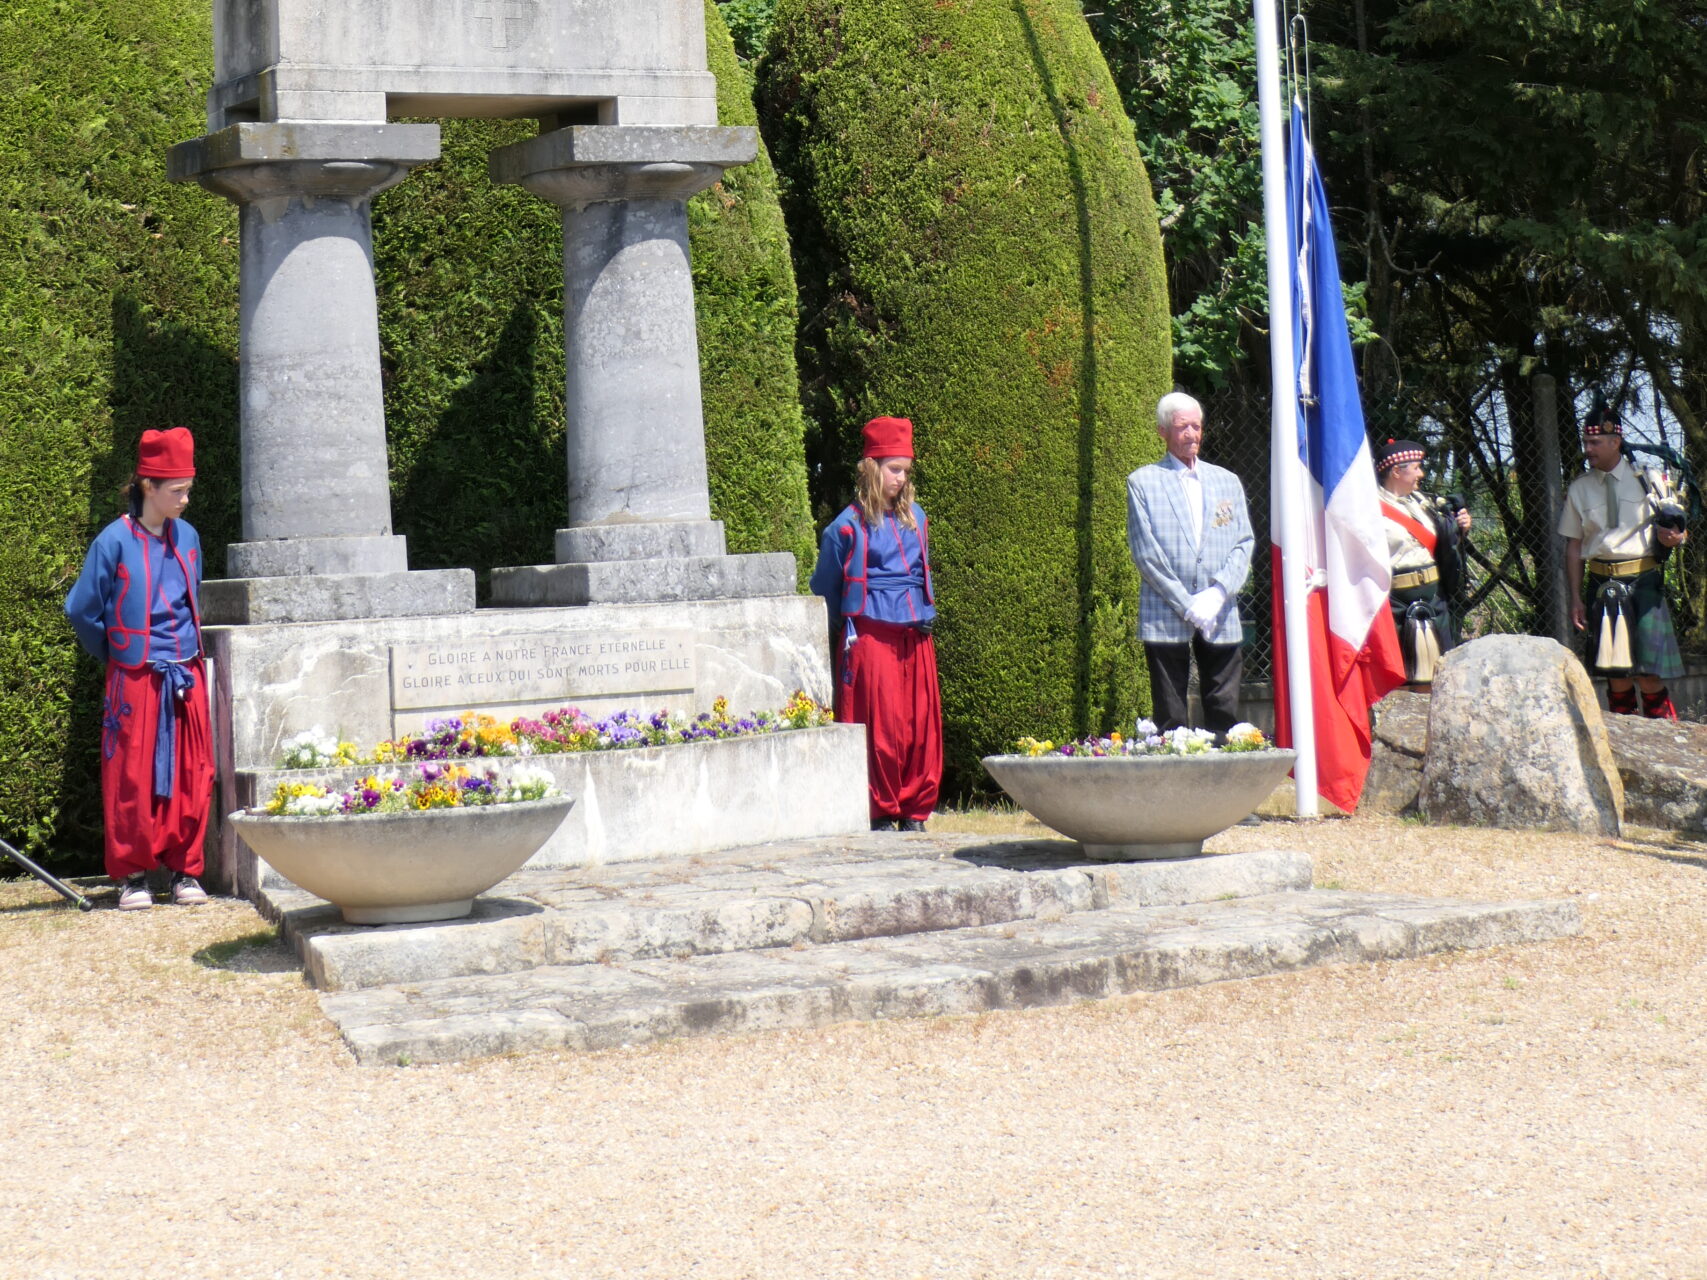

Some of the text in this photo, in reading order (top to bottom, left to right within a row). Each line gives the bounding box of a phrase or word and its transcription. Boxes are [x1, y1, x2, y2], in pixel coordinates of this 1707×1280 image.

[428, 651, 477, 665] GLOIRE
[496, 648, 537, 661] NOTRE
[544, 644, 592, 658] FRANCE
[403, 675, 451, 689] GLOIRE
[469, 671, 502, 684] CEUX
[509, 669, 531, 685] QUI
[537, 667, 570, 680] SONT
[579, 663, 619, 676] MORTS
[625, 660, 656, 673] POUR
[661, 658, 690, 671] ELLE
